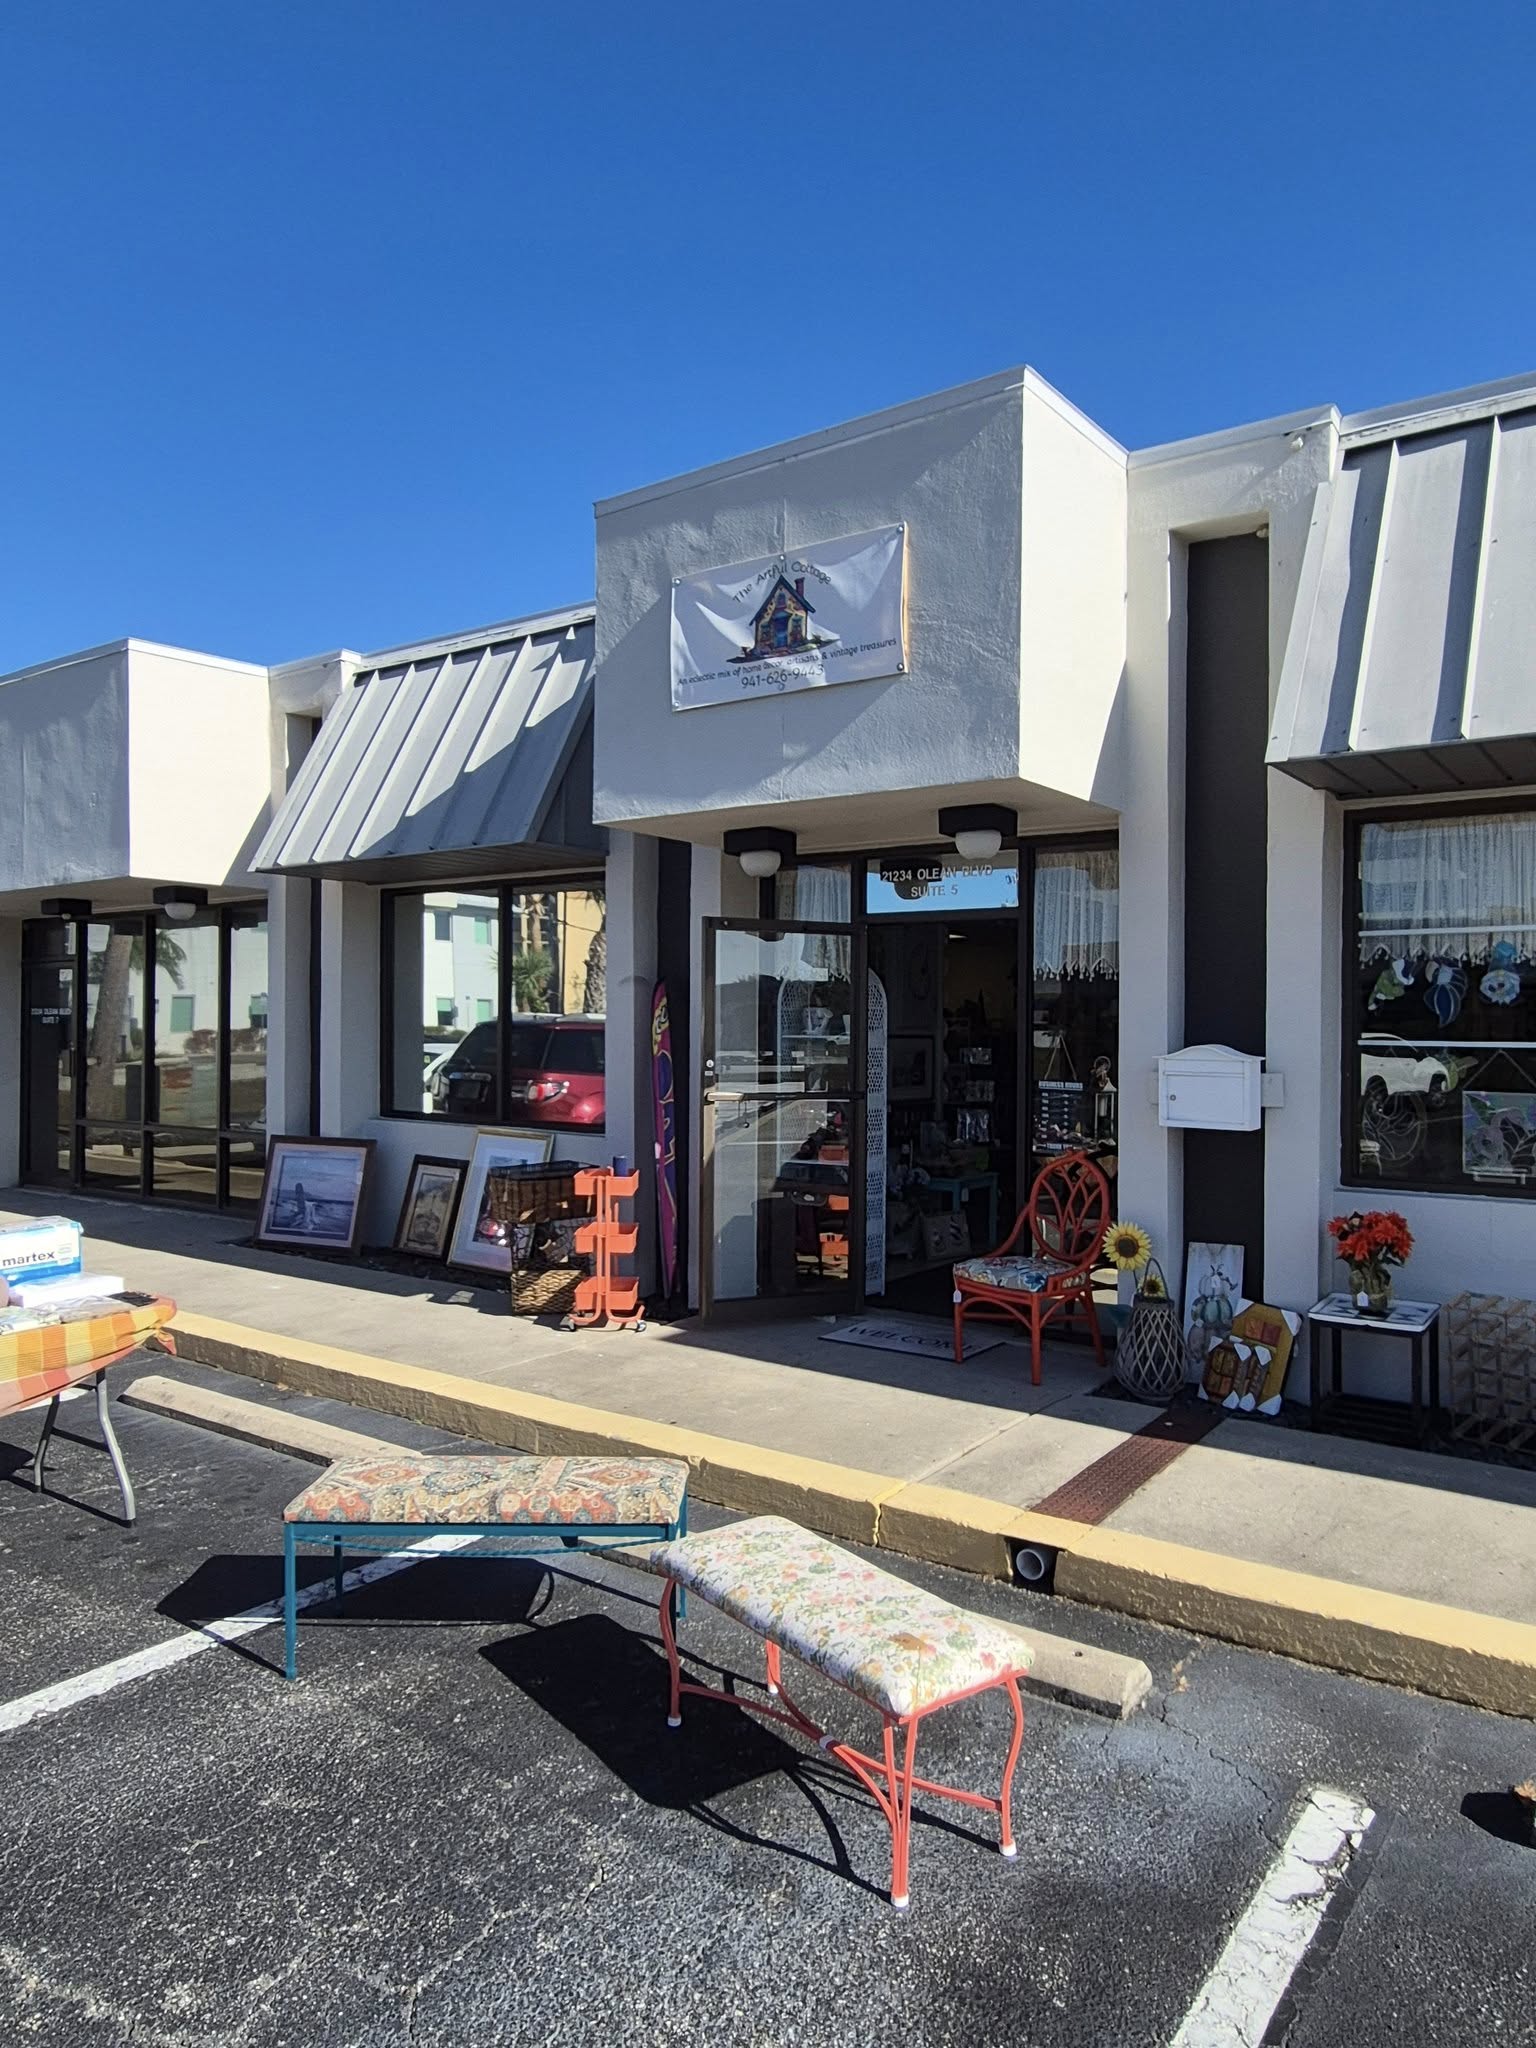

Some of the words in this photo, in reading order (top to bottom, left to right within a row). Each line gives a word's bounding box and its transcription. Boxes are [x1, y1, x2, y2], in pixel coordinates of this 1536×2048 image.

[732, 583, 753, 603] The
[756, 562, 788, 585] Artful
[791, 561, 832, 585] Cottage
[717, 668, 731, 678] mix
[829, 648, 859, 657] vintage
[860, 638, 897, 652] treasures
[741, 664, 825, 689] 941-626-9443
[882, 870, 912, 882] 21234
[917, 867, 957, 880] OLEAN
[962, 864, 993, 877] BLVD
[911, 885, 945, 898] SUITE
[951, 885, 958, 895] 5
[2, 1251, 55, 1266] martex
